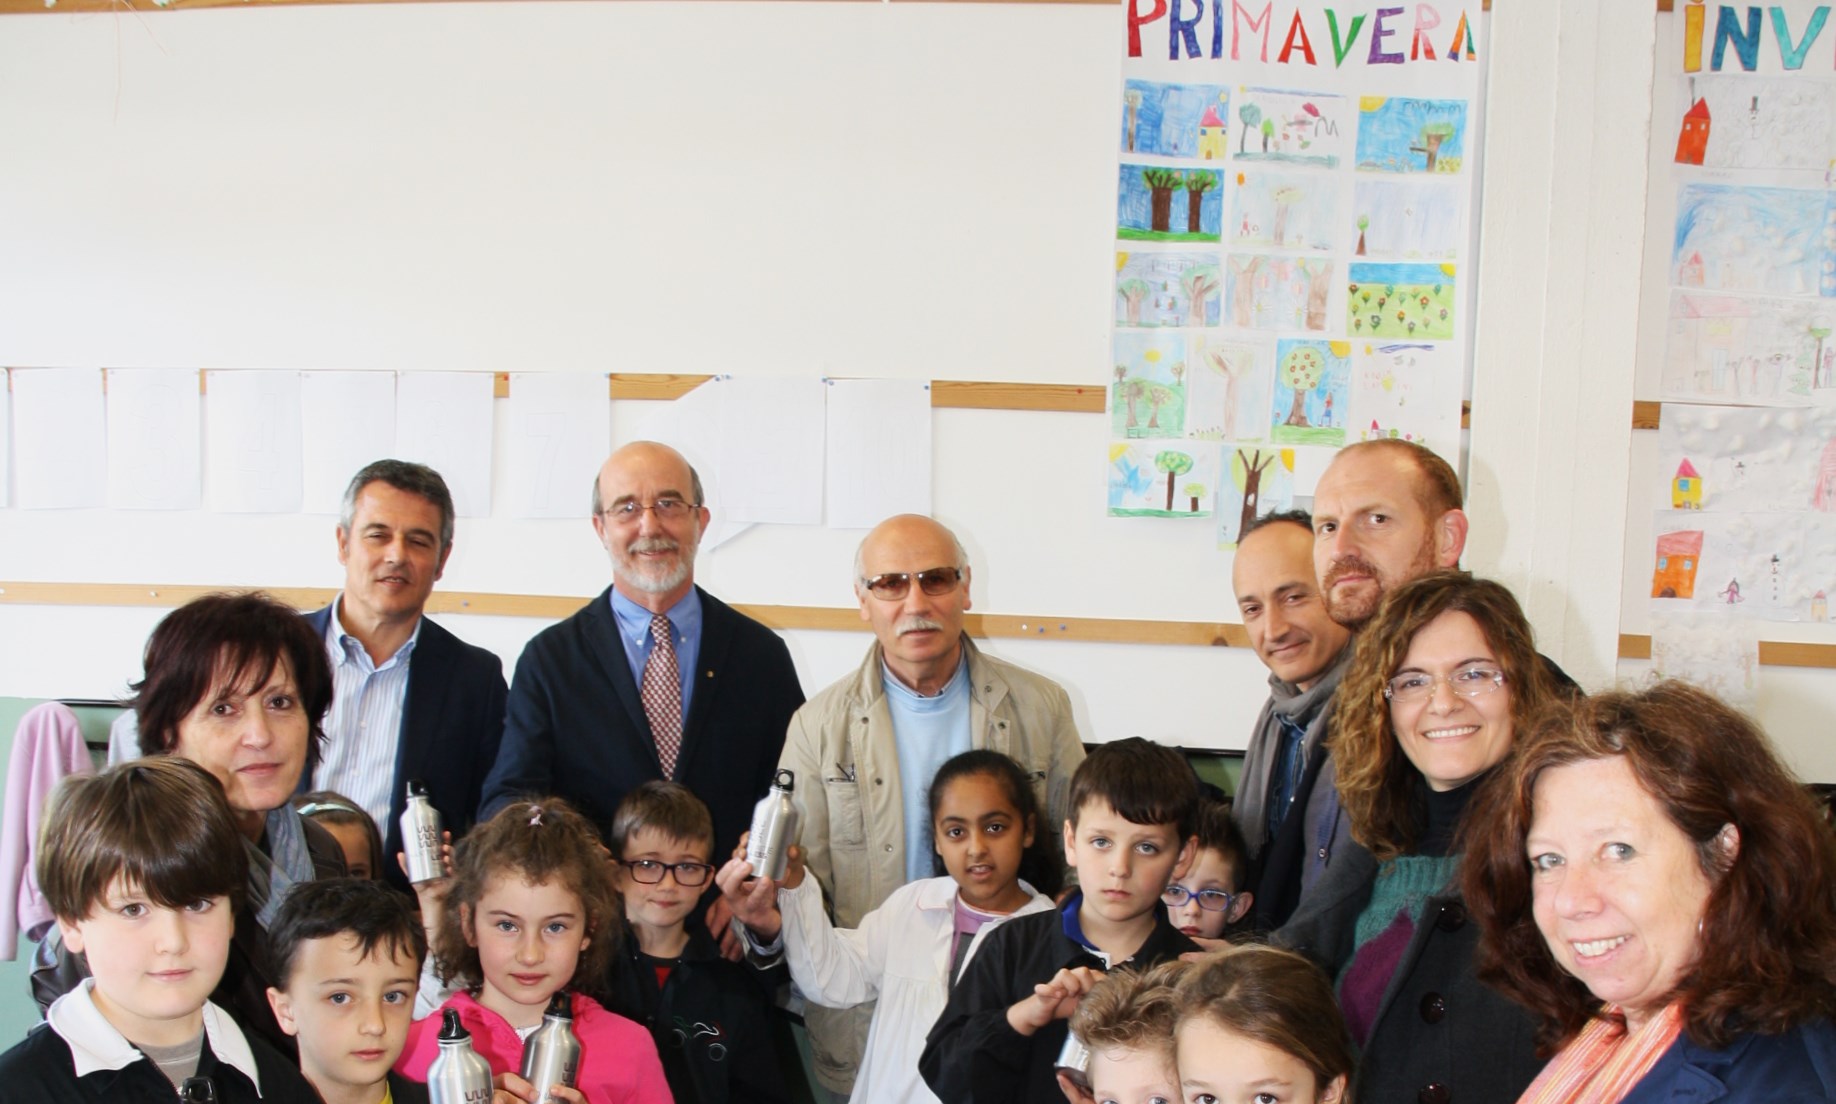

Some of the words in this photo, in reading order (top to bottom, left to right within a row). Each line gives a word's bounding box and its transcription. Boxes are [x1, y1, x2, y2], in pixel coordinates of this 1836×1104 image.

[1127, 0, 1476, 69] PRIMAVERA
[1683, 0, 1836, 73] INV
[525, 411, 566, 508] 7
